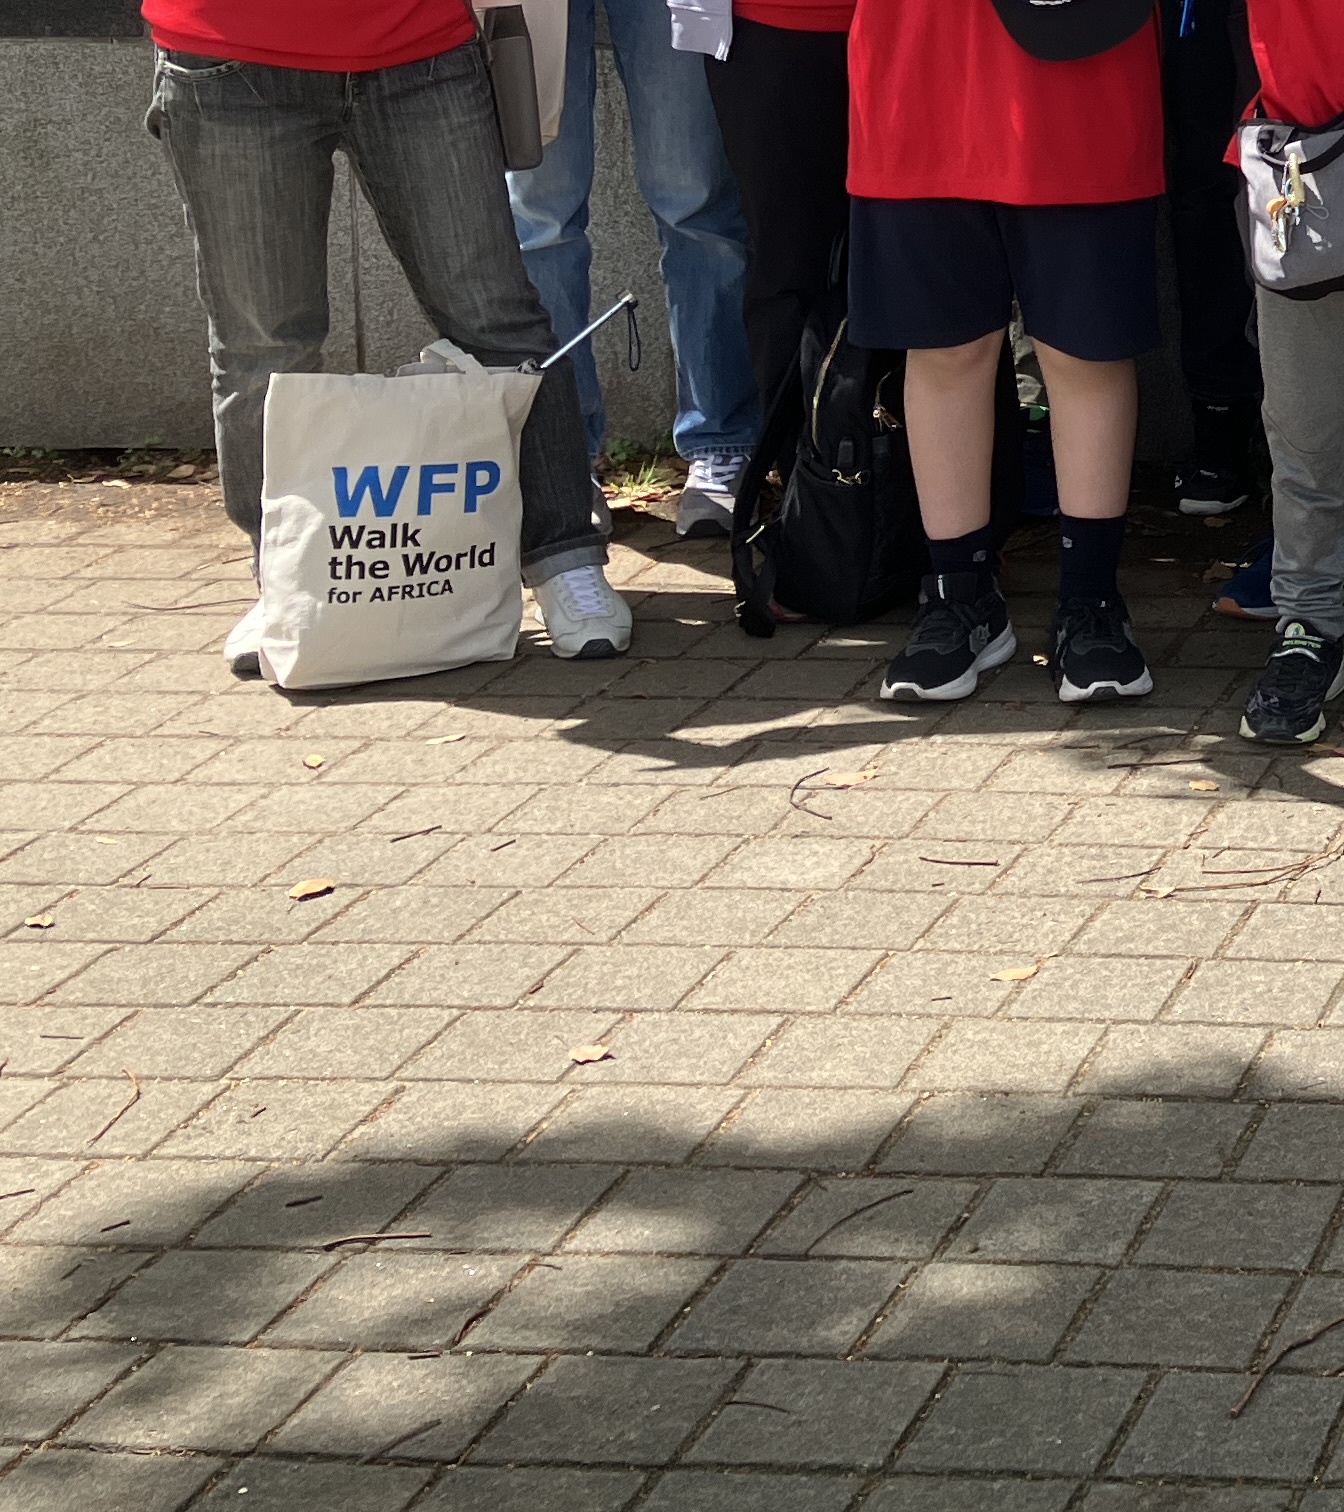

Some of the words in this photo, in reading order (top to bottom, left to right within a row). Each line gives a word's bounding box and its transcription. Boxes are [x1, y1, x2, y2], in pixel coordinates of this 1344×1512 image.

[332, 460, 501, 518] WFP
[328, 522, 422, 550] Walk
[328, 554, 390, 580] the
[401, 542, 496, 578] World
[327, 587, 362, 604] for
[369, 578, 454, 603] AFRICA
